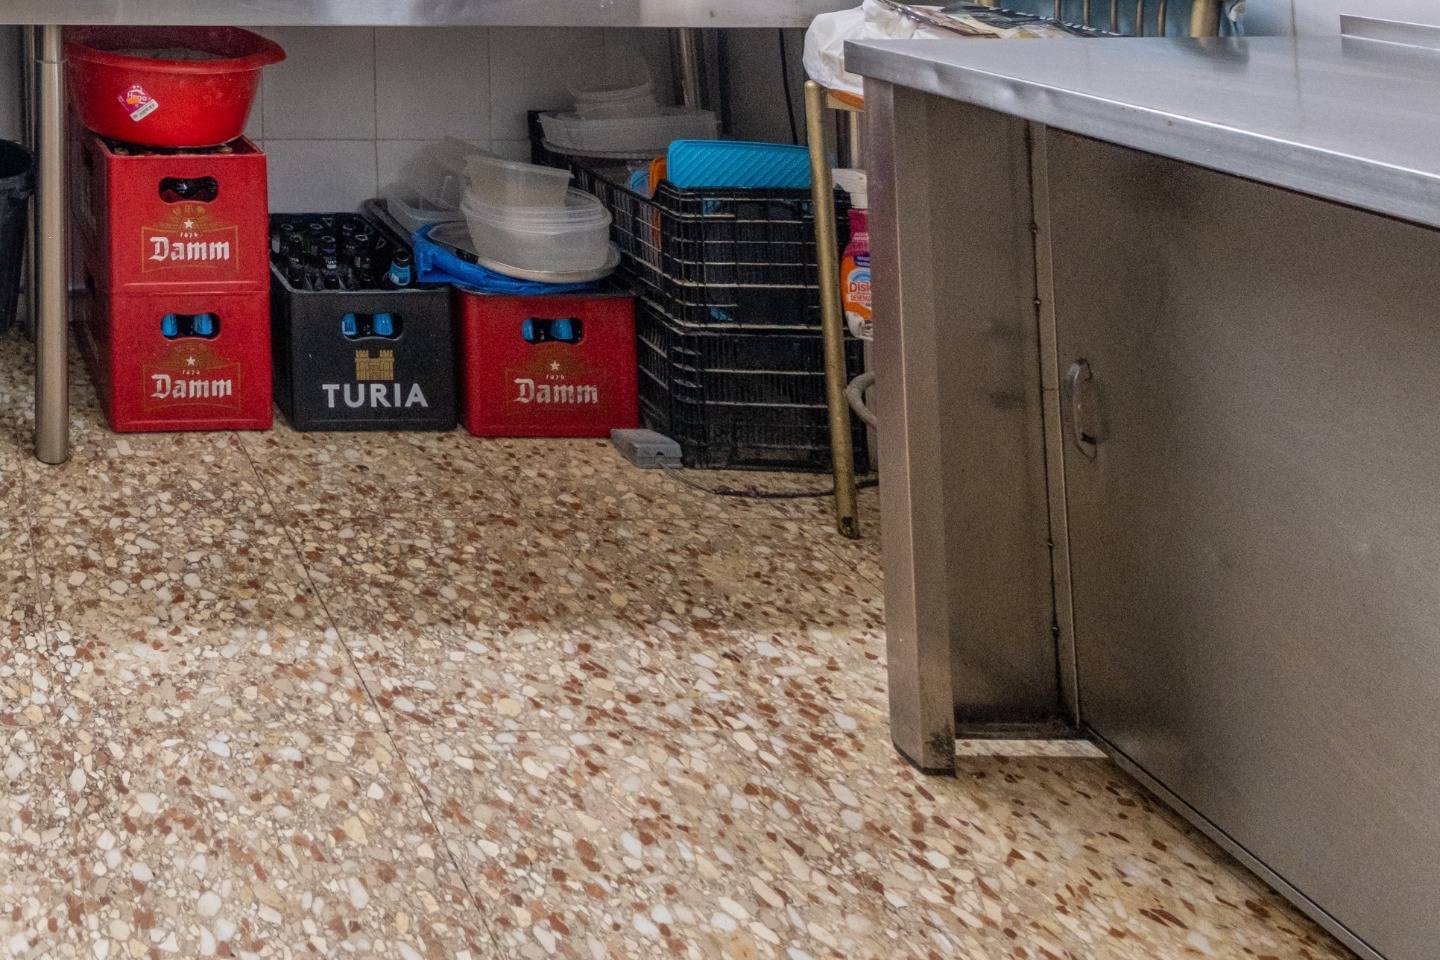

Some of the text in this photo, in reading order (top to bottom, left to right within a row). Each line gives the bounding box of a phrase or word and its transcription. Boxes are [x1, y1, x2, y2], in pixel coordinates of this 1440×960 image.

[149, 236, 230, 261] Damm
[151, 373, 232, 400] Damm
[322, 383, 429, 409] TURIA
[513, 378, 599, 405] Damm
